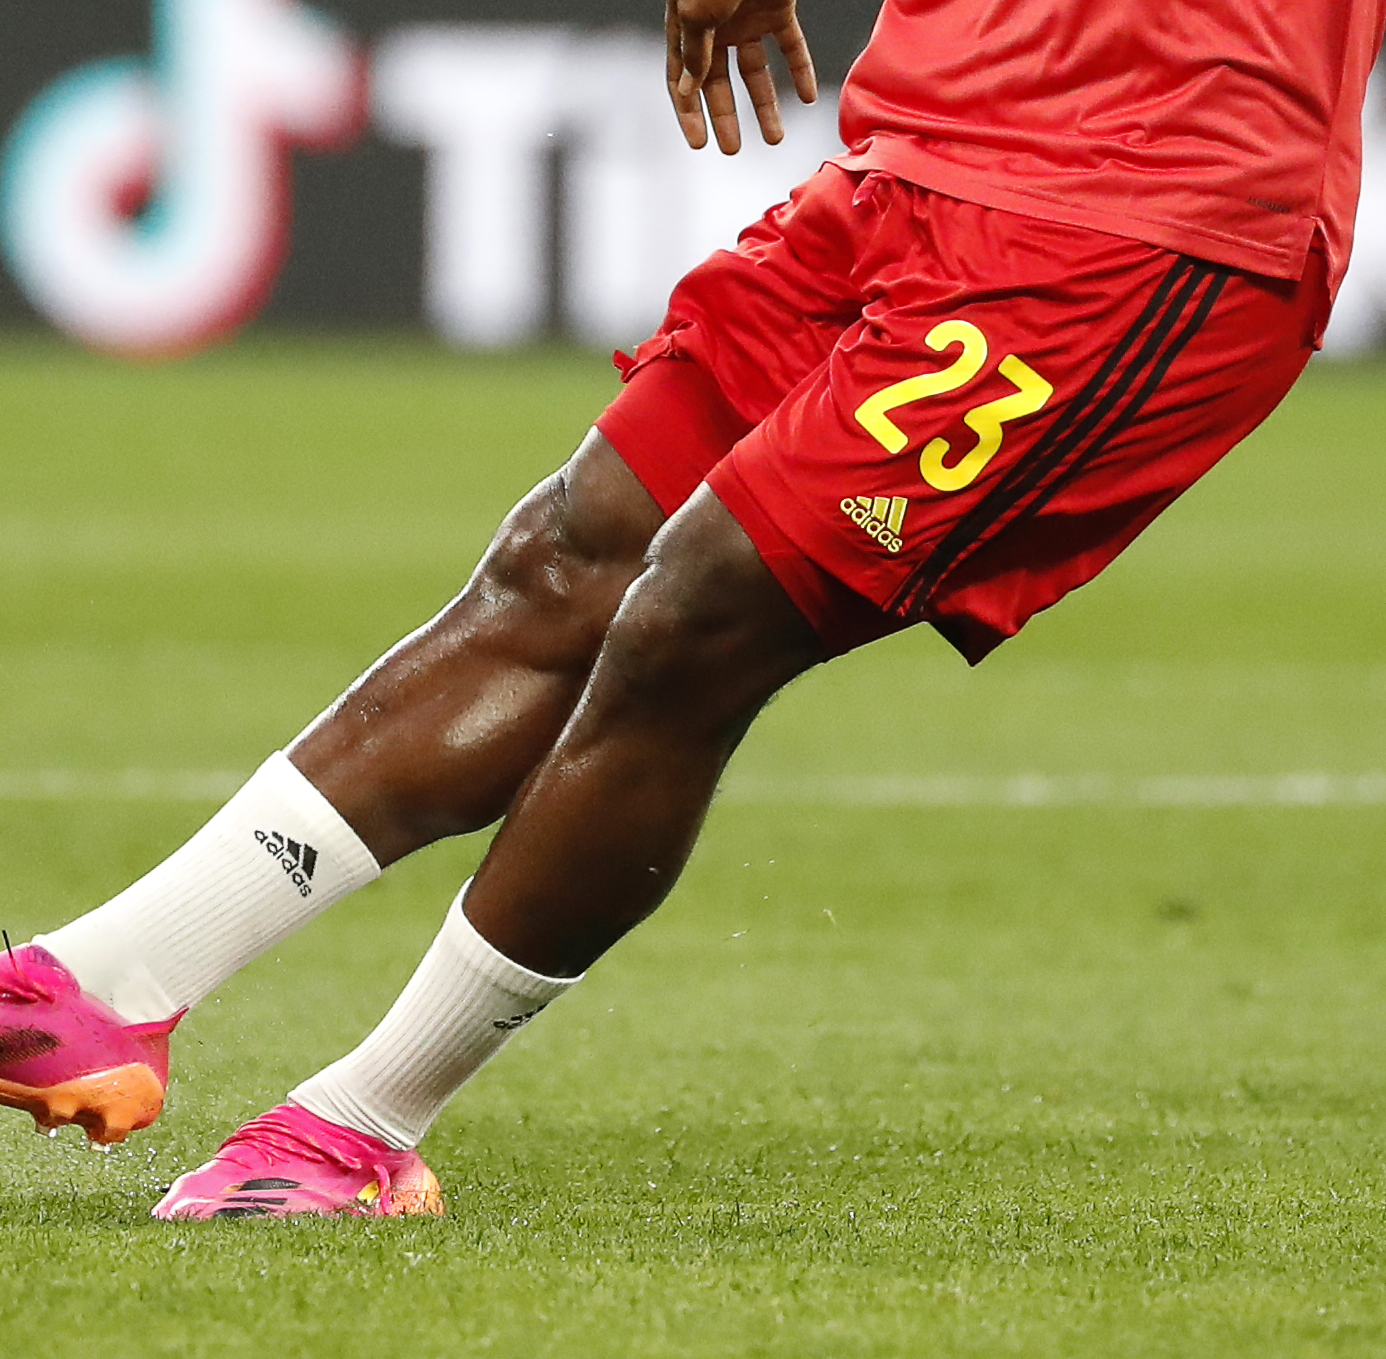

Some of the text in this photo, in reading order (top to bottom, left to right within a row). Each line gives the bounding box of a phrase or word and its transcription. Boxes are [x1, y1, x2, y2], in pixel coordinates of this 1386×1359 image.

[854, 319, 1054, 492] 23
[840, 498, 903, 553] adidas
[254, 830, 312, 897] adidas
